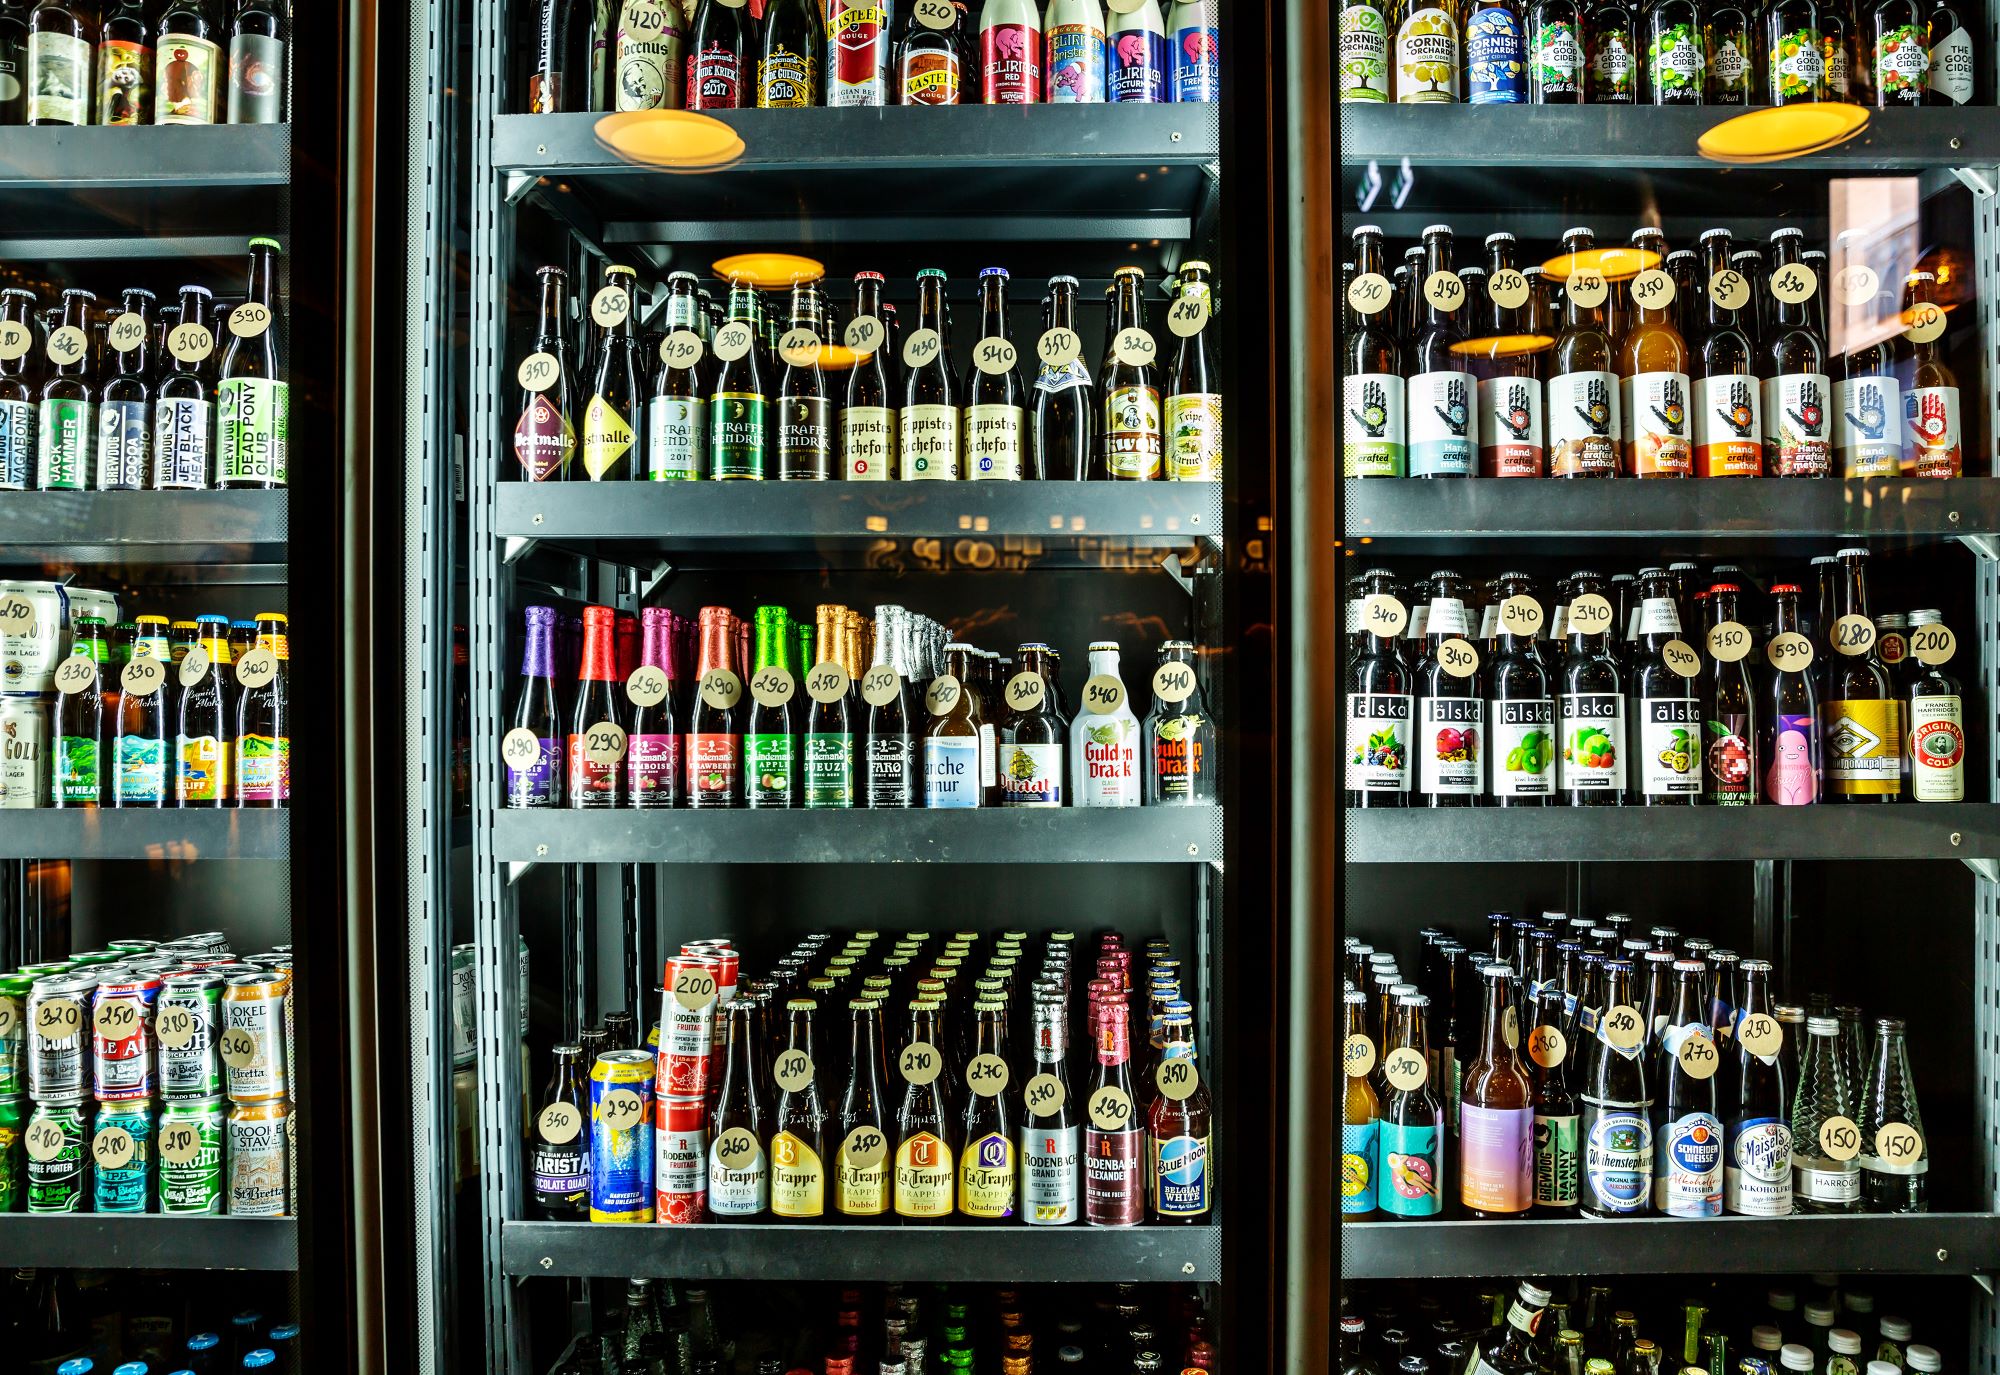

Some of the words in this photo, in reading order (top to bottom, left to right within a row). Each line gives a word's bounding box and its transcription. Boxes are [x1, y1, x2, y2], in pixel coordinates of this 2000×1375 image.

[629, 9, 661, 29] 420
[920, 3, 951, 19] 320
[841, 32, 869, 40] ROUGE
[1407, 37, 1455, 50] CORNISH
[1467, 37, 1518, 51] CORNISH
[1411, 46, 1453, 56] ORCHARDS
[1470, 47, 1515, 58] ORCHARDS
[1478, 54, 1490, 62] DRY
[1553, 47, 1577, 55] GOOD
[1553, 54, 1577, 62] CIDER
[1672, 51, 1697, 59] GOOD
[1951, 46, 1968, 54] THE
[1672, 58, 1696, 66] CIDER
[1945, 54, 1972, 63] GOOD
[714, 66, 736, 80] KRIEK
[1945, 64, 1972, 72] CIDER
[703, 83, 727, 96] 2017
[906, 70, 957, 93] KASTEEL
[770, 85, 794, 98] 2018
[921, 92, 946, 100] ROUGE
[1898, 89, 1921, 100] Apple
[1352, 280, 1382, 299] 250
[1434, 281, 1460, 298] 250
[1493, 277, 1521, 291] 250
[1573, 276, 1599, 291] 250
[1638, 278, 1663, 298] 250
[1714, 271, 1738, 300] 250
[234, 309, 265, 324] 390
[116, 322, 142, 339] 490
[721, 331, 746, 346] 380
[851, 323, 874, 346] 380
[178, 333, 209, 351] 300
[666, 341, 694, 357] 430
[912, 337, 937, 355] 430
[1124, 337, 1153, 351] 320
[983, 346, 1012, 363] 540
[242, 384, 256, 430] PONY
[179, 404, 193, 456] BLACK
[14, 405, 27, 484] VAGABOND
[61, 419, 77, 483] HAMMER
[222, 420, 234, 476] BREWDOG
[106, 436, 119, 484] BREWDOG
[139, 430, 150, 486] PSYCHO
[161, 434, 173, 481] BREWDOG
[241, 433, 254, 475] DEAD
[256, 431, 269, 475] CLUB
[1584, 451, 1612, 460] crafted
[1726, 453, 1755, 462] crafted
[49, 444, 62, 482] JACK
[125, 438, 139, 485] COCOA
[179, 458, 189, 481] JET
[857, 462, 865, 471] 6
[918, 460, 925, 468] 8
[981, 460, 991, 469] 10
[1581, 459, 1615, 468] method
[1724, 461, 1758, 471] method
[1372, 605, 1398, 622] 340
[1506, 606, 1538, 622] 340
[1574, 605, 1610, 621] 340
[1712, 631, 1743, 647] 750
[1839, 624, 1871, 647] 280
[1916, 632, 1949, 651] 200
[1445, 647, 1472, 666] 340
[1668, 649, 1694, 663] 340
[1775, 642, 1809, 658] 590
[62, 665, 91, 680] 330
[127, 664, 154, 680] 330
[242, 660, 269, 678] 300
[630, 678, 662, 694] 290
[705, 677, 733, 694] 290
[754, 674, 788, 693] 290
[812, 674, 839, 690] 250
[866, 673, 893, 691] 250
[1159, 671, 1189, 690] 340
[930, 686, 957, 702] 250
[1014, 682, 1038, 700] 320
[1090, 685, 1118, 703] 340
[1917, 723, 1961, 740] ORIGINAL
[589, 733, 621, 751] 290
[1926, 758, 1954, 767] COLA
[65, 785, 100, 796] WHEAT
[676, 977, 712, 995] 200
[40, 1008, 77, 1026] 320
[100, 1006, 134, 1023] 250
[162, 1012, 189, 1033] 280
[1609, 1013, 1635, 1031] 250
[1745, 1020, 1771, 1038] 250
[223, 1041, 249, 1054] 360
[1532, 1036, 1557, 1053] 280
[1684, 1043, 1713, 1061] 270
[781, 1057, 806, 1077] 250
[607, 1100, 639, 1118] 290
[1096, 1099, 1127, 1118] 290
[547, 1113, 569, 1127] 350
[165, 1131, 192, 1150] 280
[852, 1134, 880, 1153] 250
[1826, 1128, 1856, 1148] 150
[1885, 1136, 1915, 1156] 150
[663, 1150, 705, 1160] RODENBACH
[722, 1137, 749, 1157] 260
[1678, 1143, 1718, 1153] SCHNEIDER
[1158, 1159, 1183, 1174] BLUE
[1684, 1154, 1714, 1163] WEISSE
[53, 1162, 73, 1172] PORTER
[105, 1171, 129, 1179] IPA
[1032, 1169, 1056, 1177] GRAND
[1406, 1160, 1428, 1177] SPOT
[1559, 1149, 1569, 1200] NANNY
[1540, 1152, 1552, 1201] BREWDOG
[1569, 1151, 1577, 1200] STATE
[568, 1179, 587, 1189] QUAD
[1165, 1186, 1201, 1194] BELGIAN
[1165, 1193, 1200, 1202] WHITE
[912, 1203, 936, 1211] Tripel
